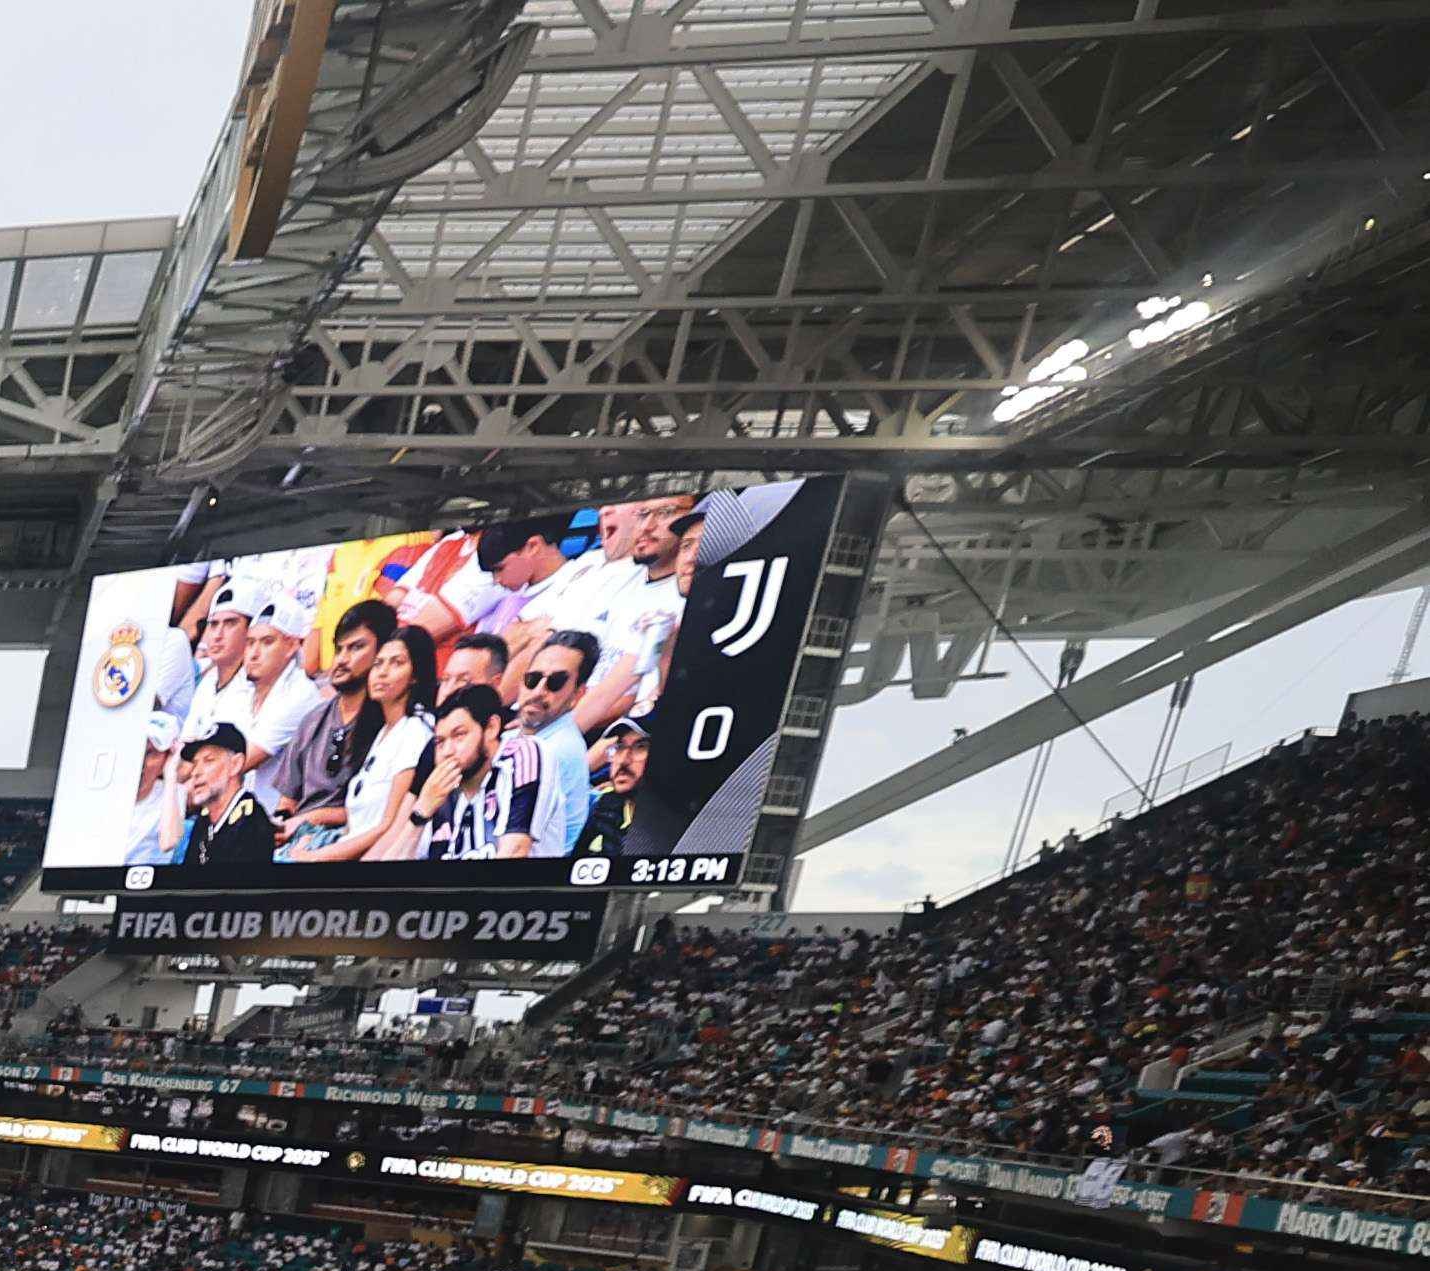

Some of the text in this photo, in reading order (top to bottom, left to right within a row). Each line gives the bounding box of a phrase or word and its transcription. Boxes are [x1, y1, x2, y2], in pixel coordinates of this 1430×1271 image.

[689, 706, 735, 760] 0
[631, 857, 729, 882] 3:13 PM
[117, 911, 178, 939] FIFA
[183, 911, 264, 940] CLUB
[269, 911, 391, 940] WORLD
[396, 910, 470, 941] CUP
[23, 1065, 41, 1078] 57
[218, 1079, 241, 1093] 67
[325, 1087, 477, 1110] RICHMOND WEBB 78
[1276, 1202, 1334, 1240] MARK
[1336, 1211, 1405, 1251] DUPER
